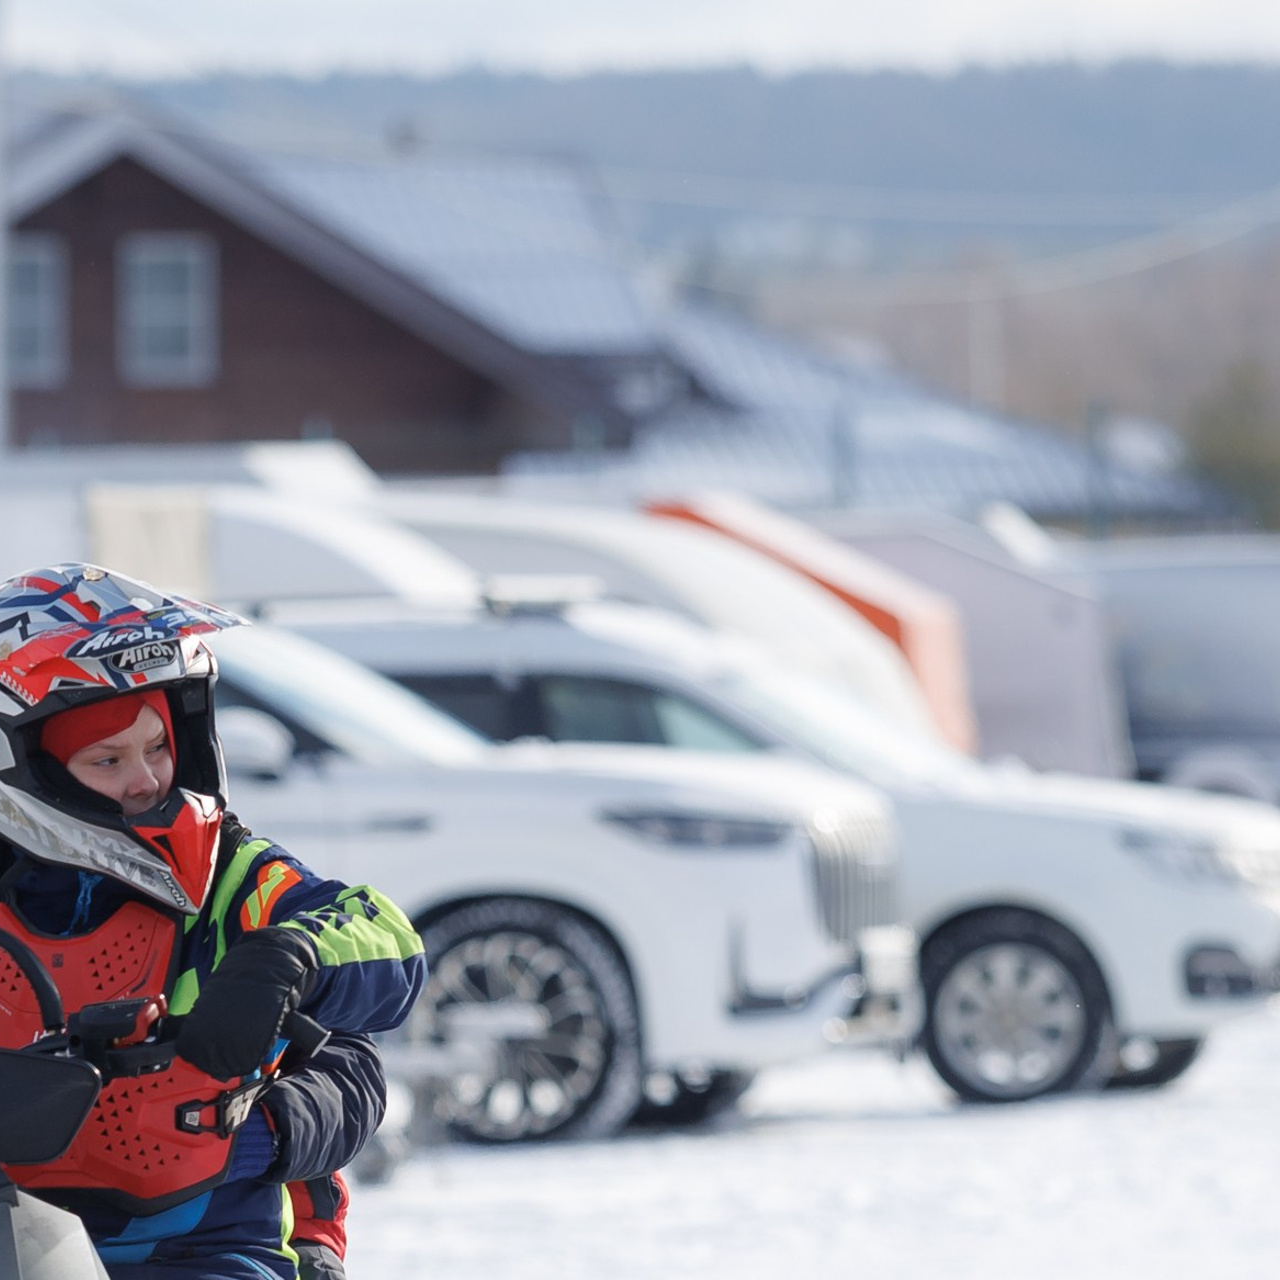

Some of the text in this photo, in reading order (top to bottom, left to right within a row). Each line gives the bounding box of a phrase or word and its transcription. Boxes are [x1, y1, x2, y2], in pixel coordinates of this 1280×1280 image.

[76, 626, 165, 656] Airoh
[118, 642, 174, 668] Airoh
[158, 868, 187, 908] Airoh
